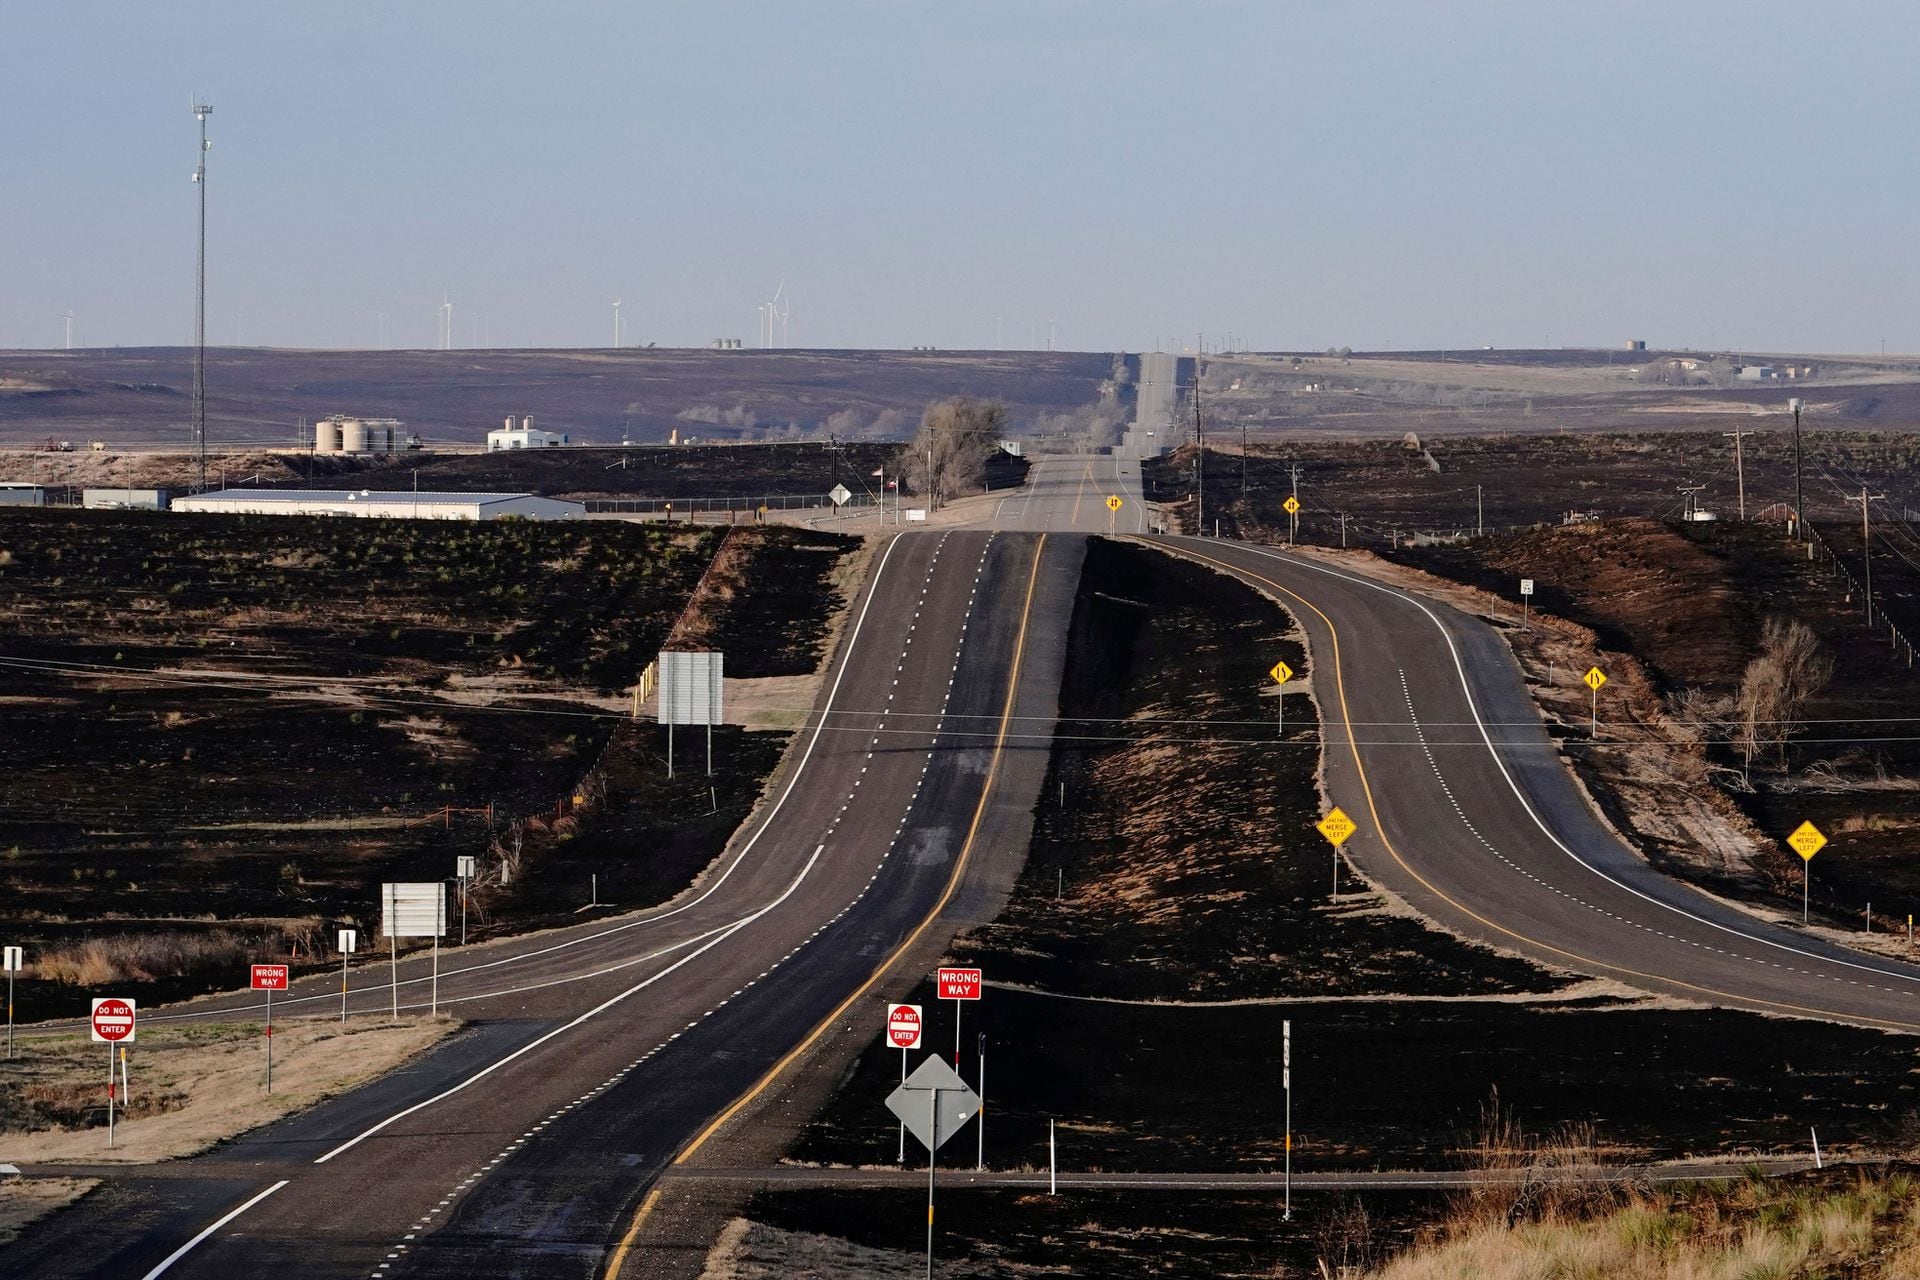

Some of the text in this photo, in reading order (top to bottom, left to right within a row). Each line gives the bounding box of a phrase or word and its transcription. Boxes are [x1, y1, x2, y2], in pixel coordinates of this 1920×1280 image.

[941, 973, 978, 983] WRONG
[948, 985, 971, 995] WAY
[894, 1032, 914, 1040] ENTER
